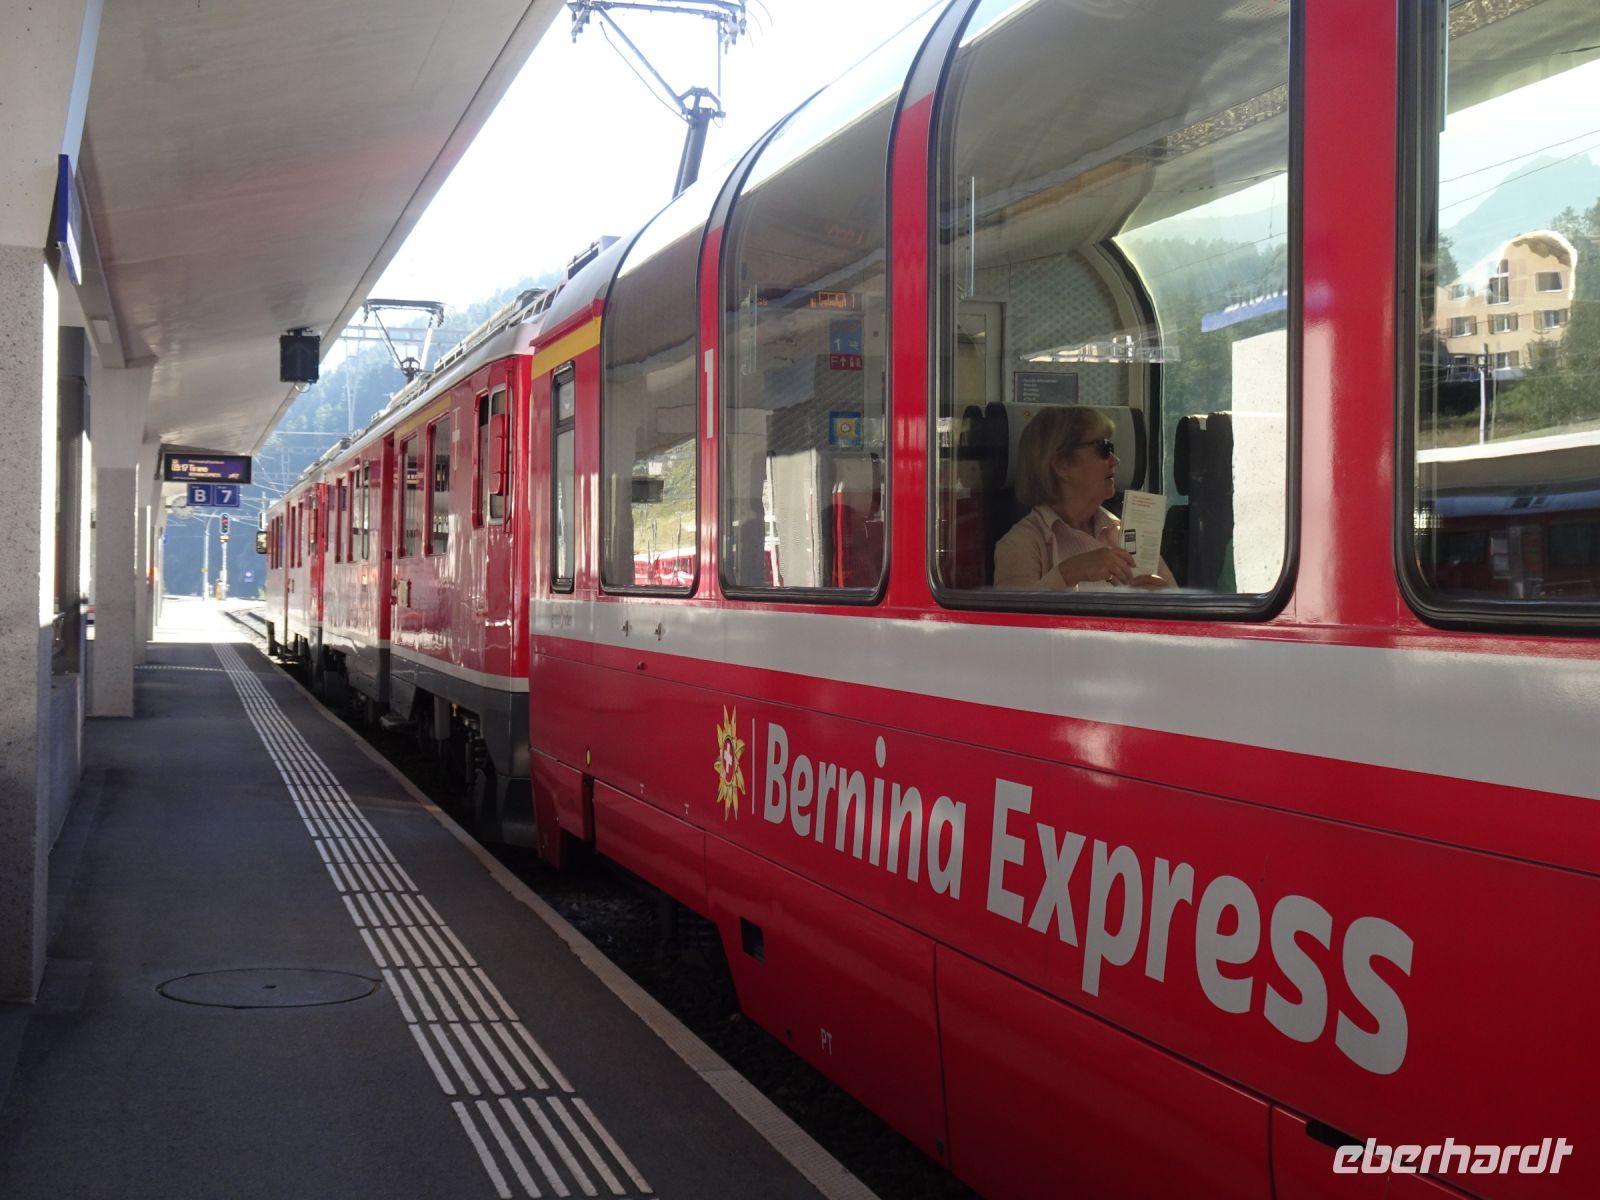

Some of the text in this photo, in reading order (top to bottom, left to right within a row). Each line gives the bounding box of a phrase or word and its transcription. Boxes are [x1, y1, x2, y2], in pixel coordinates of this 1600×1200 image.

[704, 348, 714, 440] 1
[194, 489, 207, 502] B
[221, 489, 232, 503] 7
[763, 722, 1415, 1076] Bernina Express
[820, 1027, 833, 1057] PT
